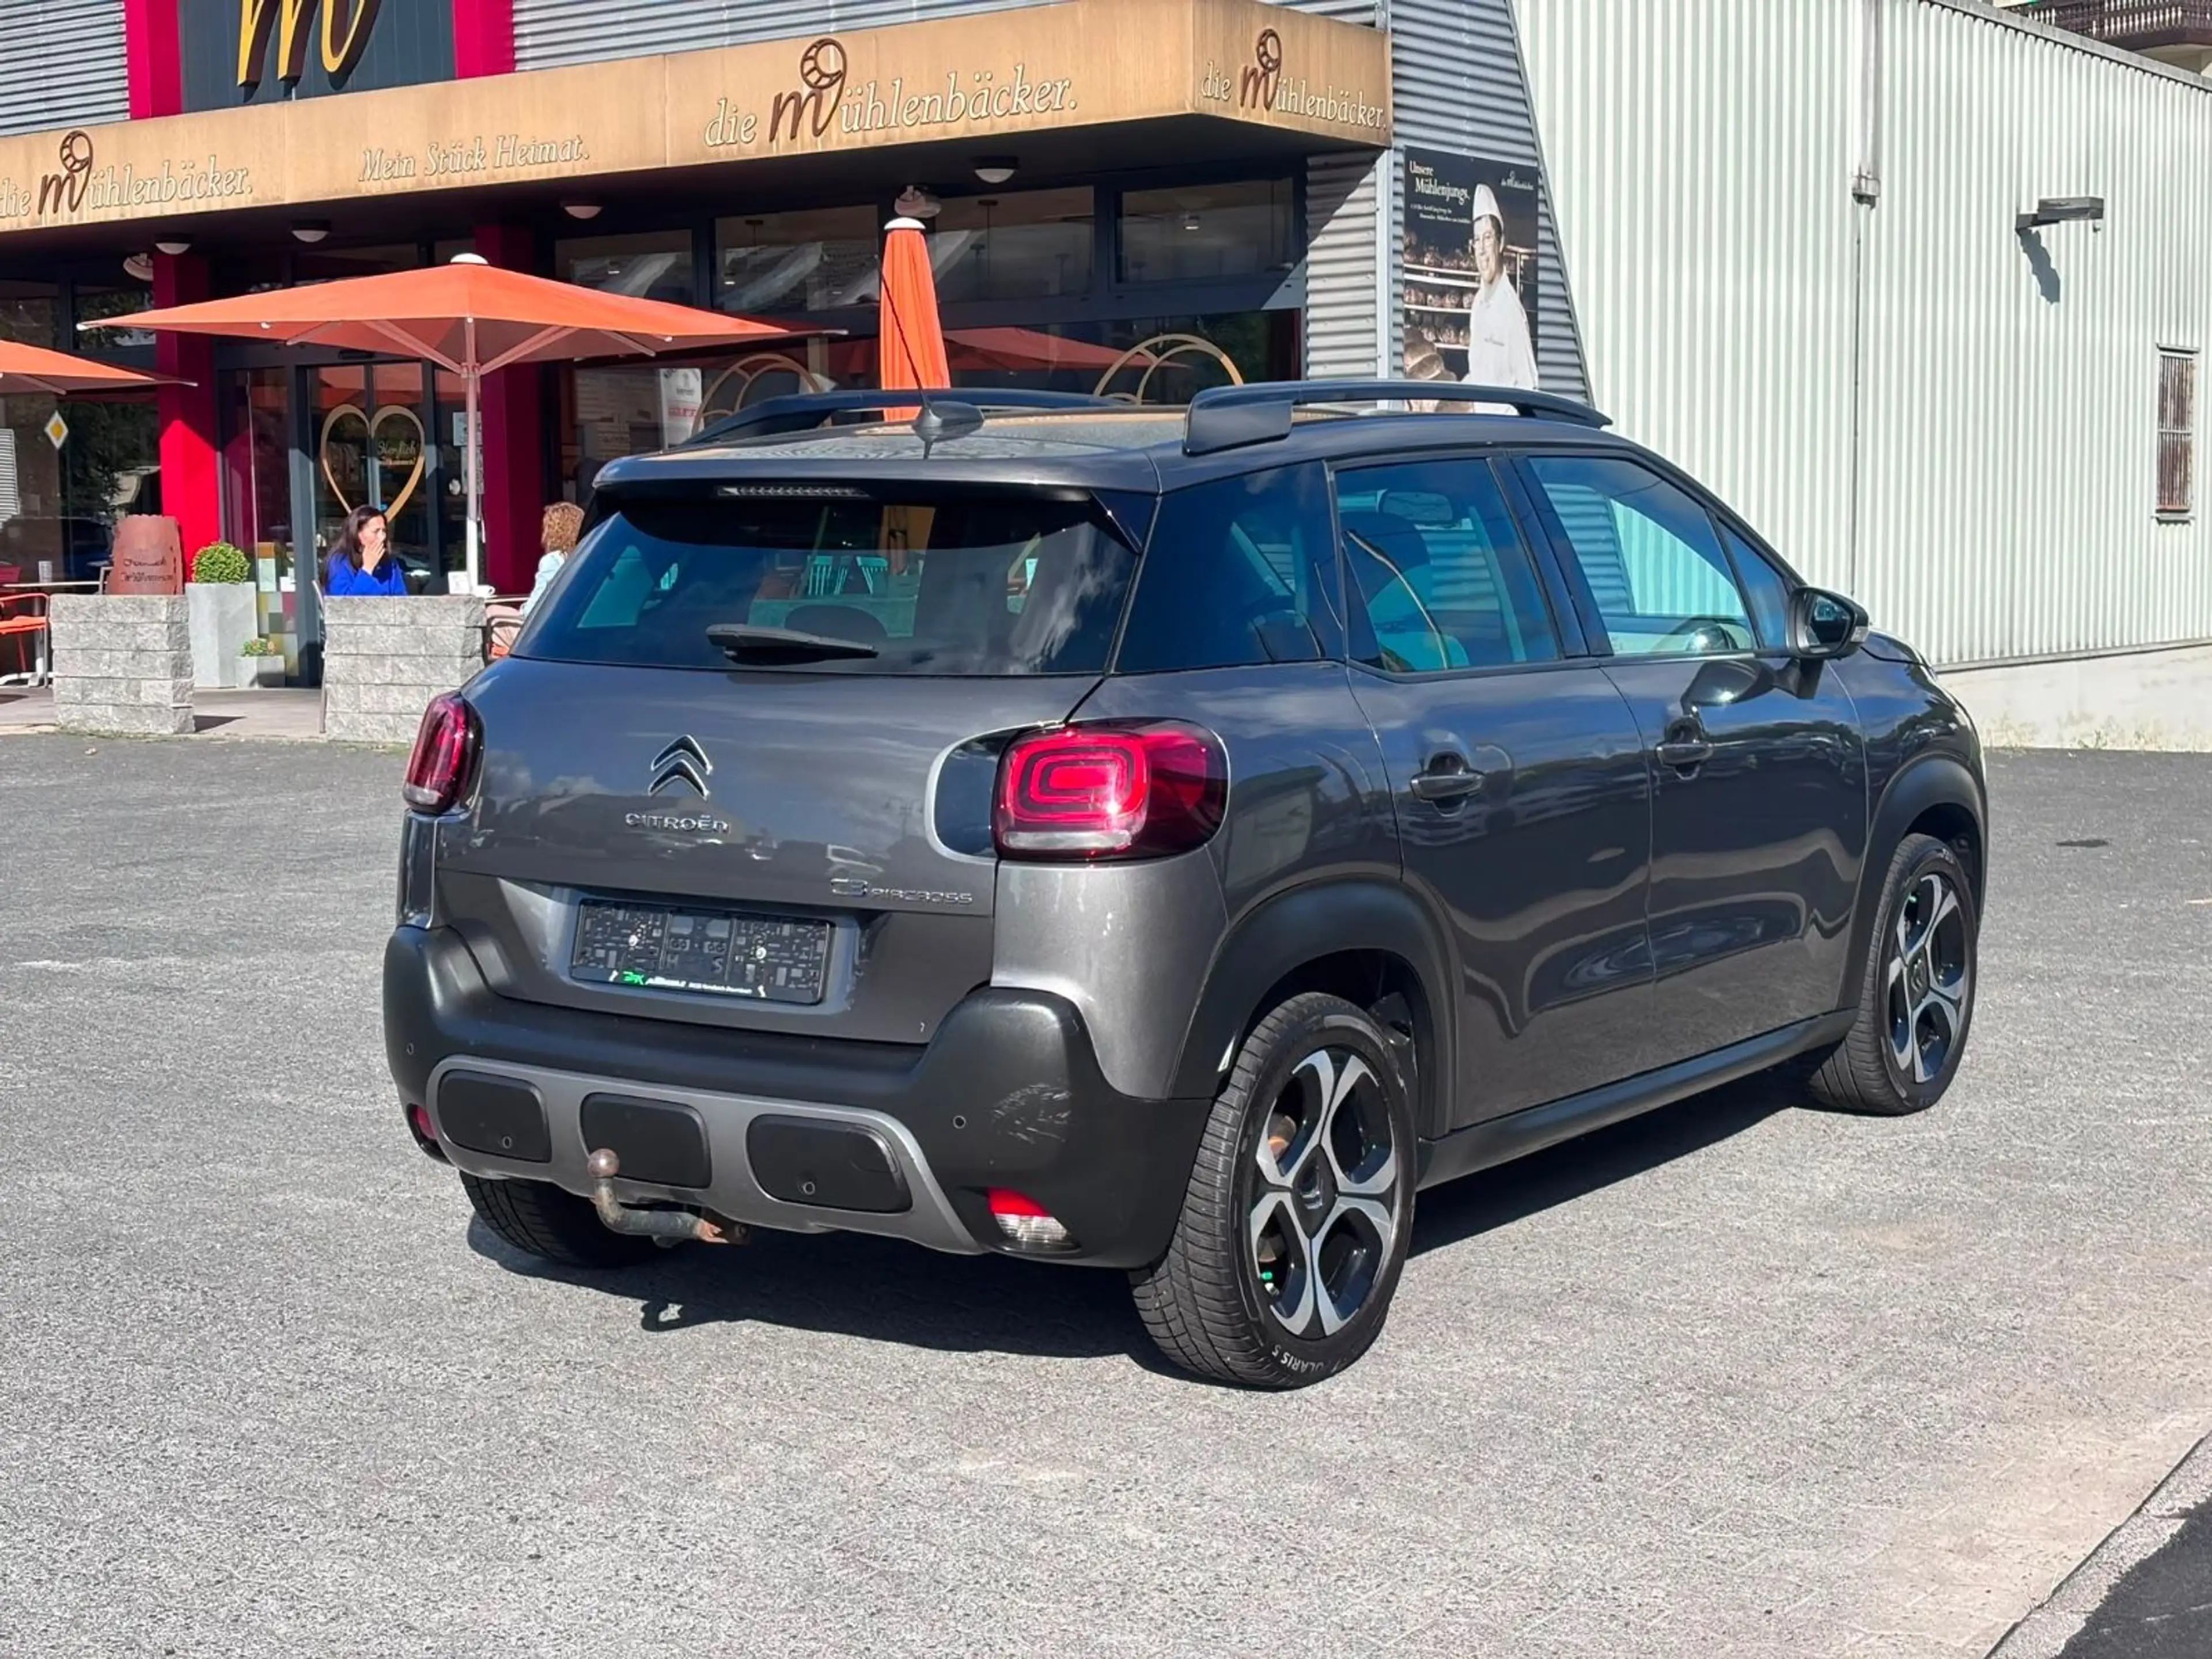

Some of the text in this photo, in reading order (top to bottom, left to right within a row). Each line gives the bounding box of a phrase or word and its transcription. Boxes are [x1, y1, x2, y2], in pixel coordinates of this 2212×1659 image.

[1202, 60, 1231, 101] die
[704, 97, 757, 146] die
[358, 134, 589, 181] Mein Stück Heimat.
[1410, 160, 1434, 176] Unsere
